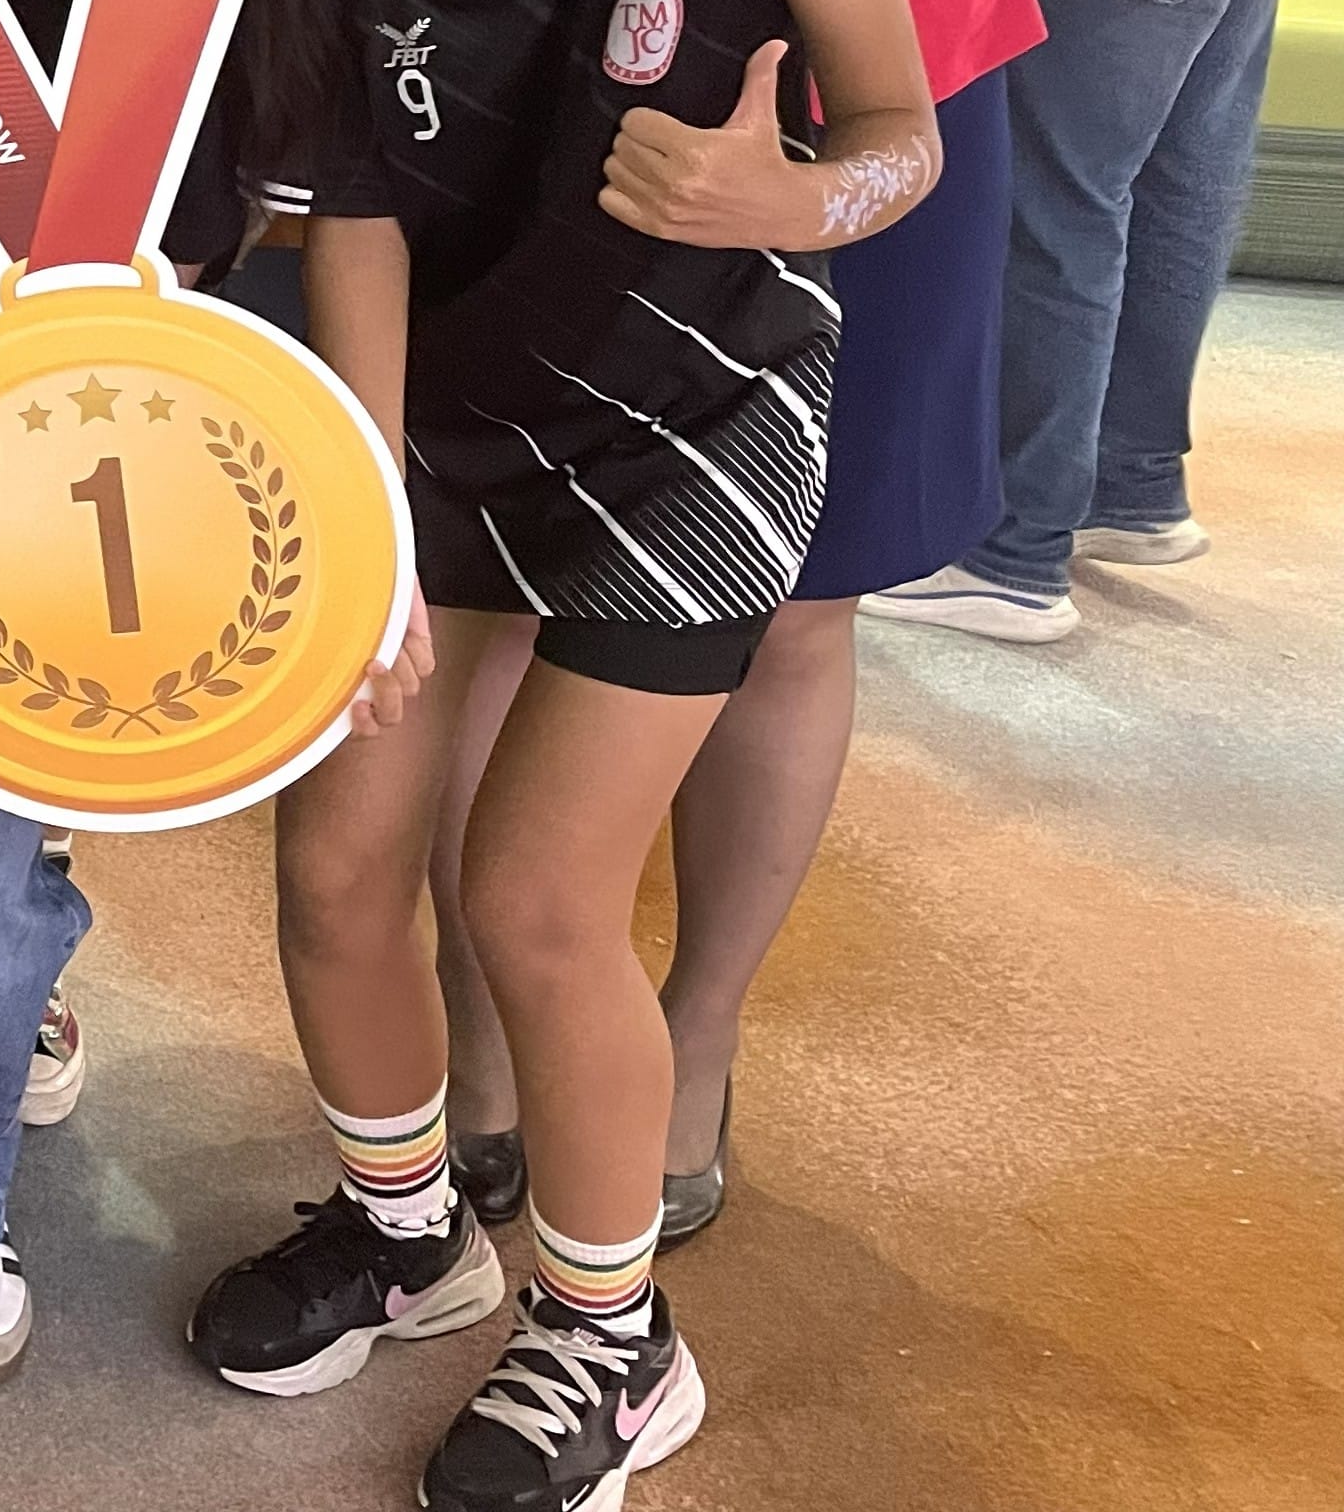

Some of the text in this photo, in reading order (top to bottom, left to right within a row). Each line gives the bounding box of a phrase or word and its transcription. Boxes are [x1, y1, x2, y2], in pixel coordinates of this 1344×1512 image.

[383, 44, 438, 68] FBT
[396, 68, 442, 141] 9
[69, 456, 141, 634] 1
